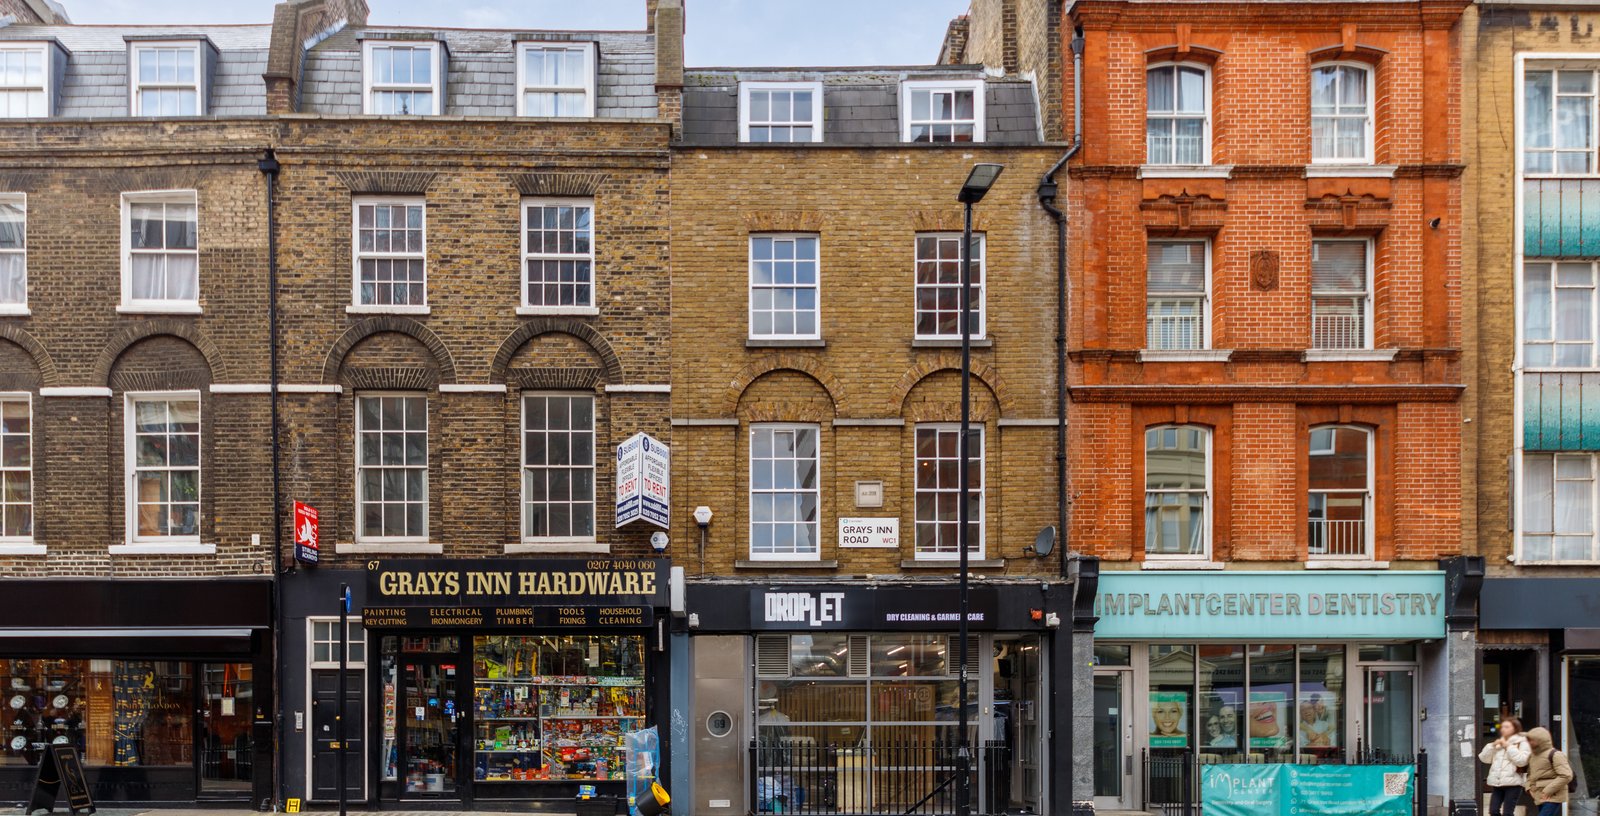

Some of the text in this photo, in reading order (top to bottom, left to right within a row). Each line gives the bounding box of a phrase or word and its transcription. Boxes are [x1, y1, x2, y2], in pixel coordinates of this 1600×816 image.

[644, 455, 666, 470] AFFORDABLE
[648, 464, 664, 476] FLEXIBLE
[648, 472, 662, 484] OFFICES
[618, 478, 638, 496] TO RENT
[644, 478, 651, 492] TO
[652, 481, 666, 498] RENT
[842, 526, 893, 534] GRAYS INN
[843, 536, 869, 544] ROAD
[368, 560, 380, 571] 67
[587, 560, 656, 570] 0207 4040 060
[380, 572, 656, 595] GRAYS INN HARDWARE
[764, 592, 845, 626] DROPLET
[1095, 592, 1442, 616] IMPLANTCENTER DENTISTRY
[886, 613, 900, 621] DRY
[900, 613, 930, 621] CLEANING
[937, 613, 960, 621] GARME
[967, 613, 985, 621] CARE
